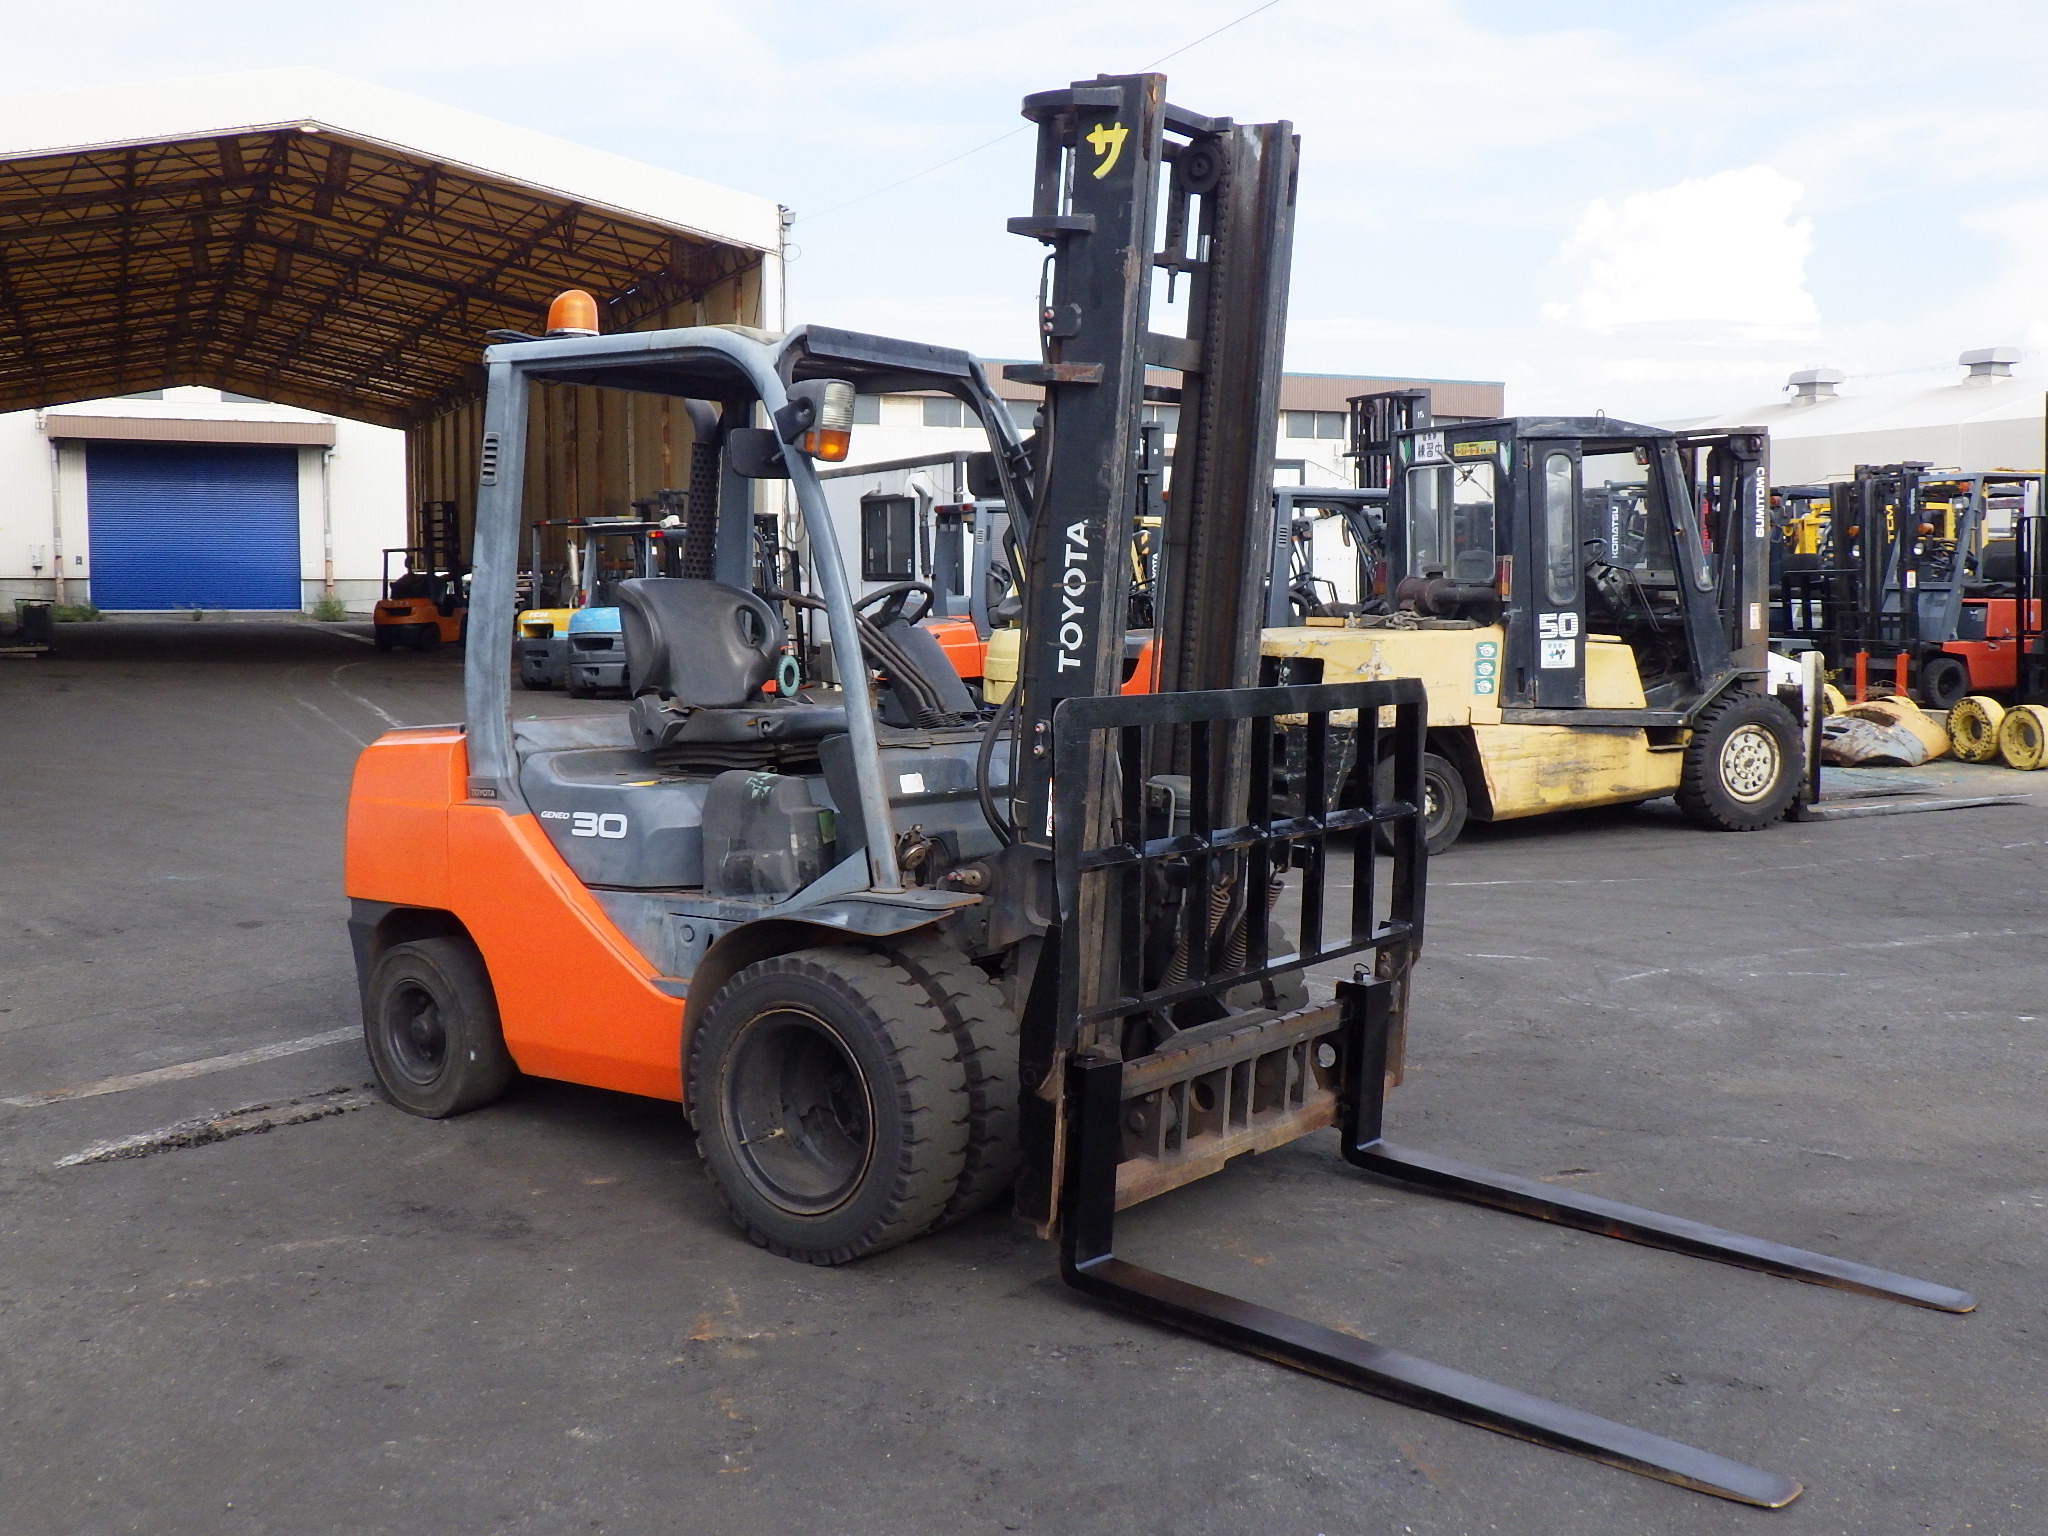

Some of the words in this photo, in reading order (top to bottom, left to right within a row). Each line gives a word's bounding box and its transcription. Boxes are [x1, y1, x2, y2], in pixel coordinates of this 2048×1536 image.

[1086, 122, 1129, 180] サ
[1756, 466, 1765, 538] SUMITOMO
[1885, 504, 1895, 544] TCM
[1057, 519, 1089, 673] TOYOTA
[1539, 612, 1578, 638] 50
[470, 788, 495, 797] TOYOTA
[540, 810, 570, 820] GENEO
[571, 811, 628, 839] 30
